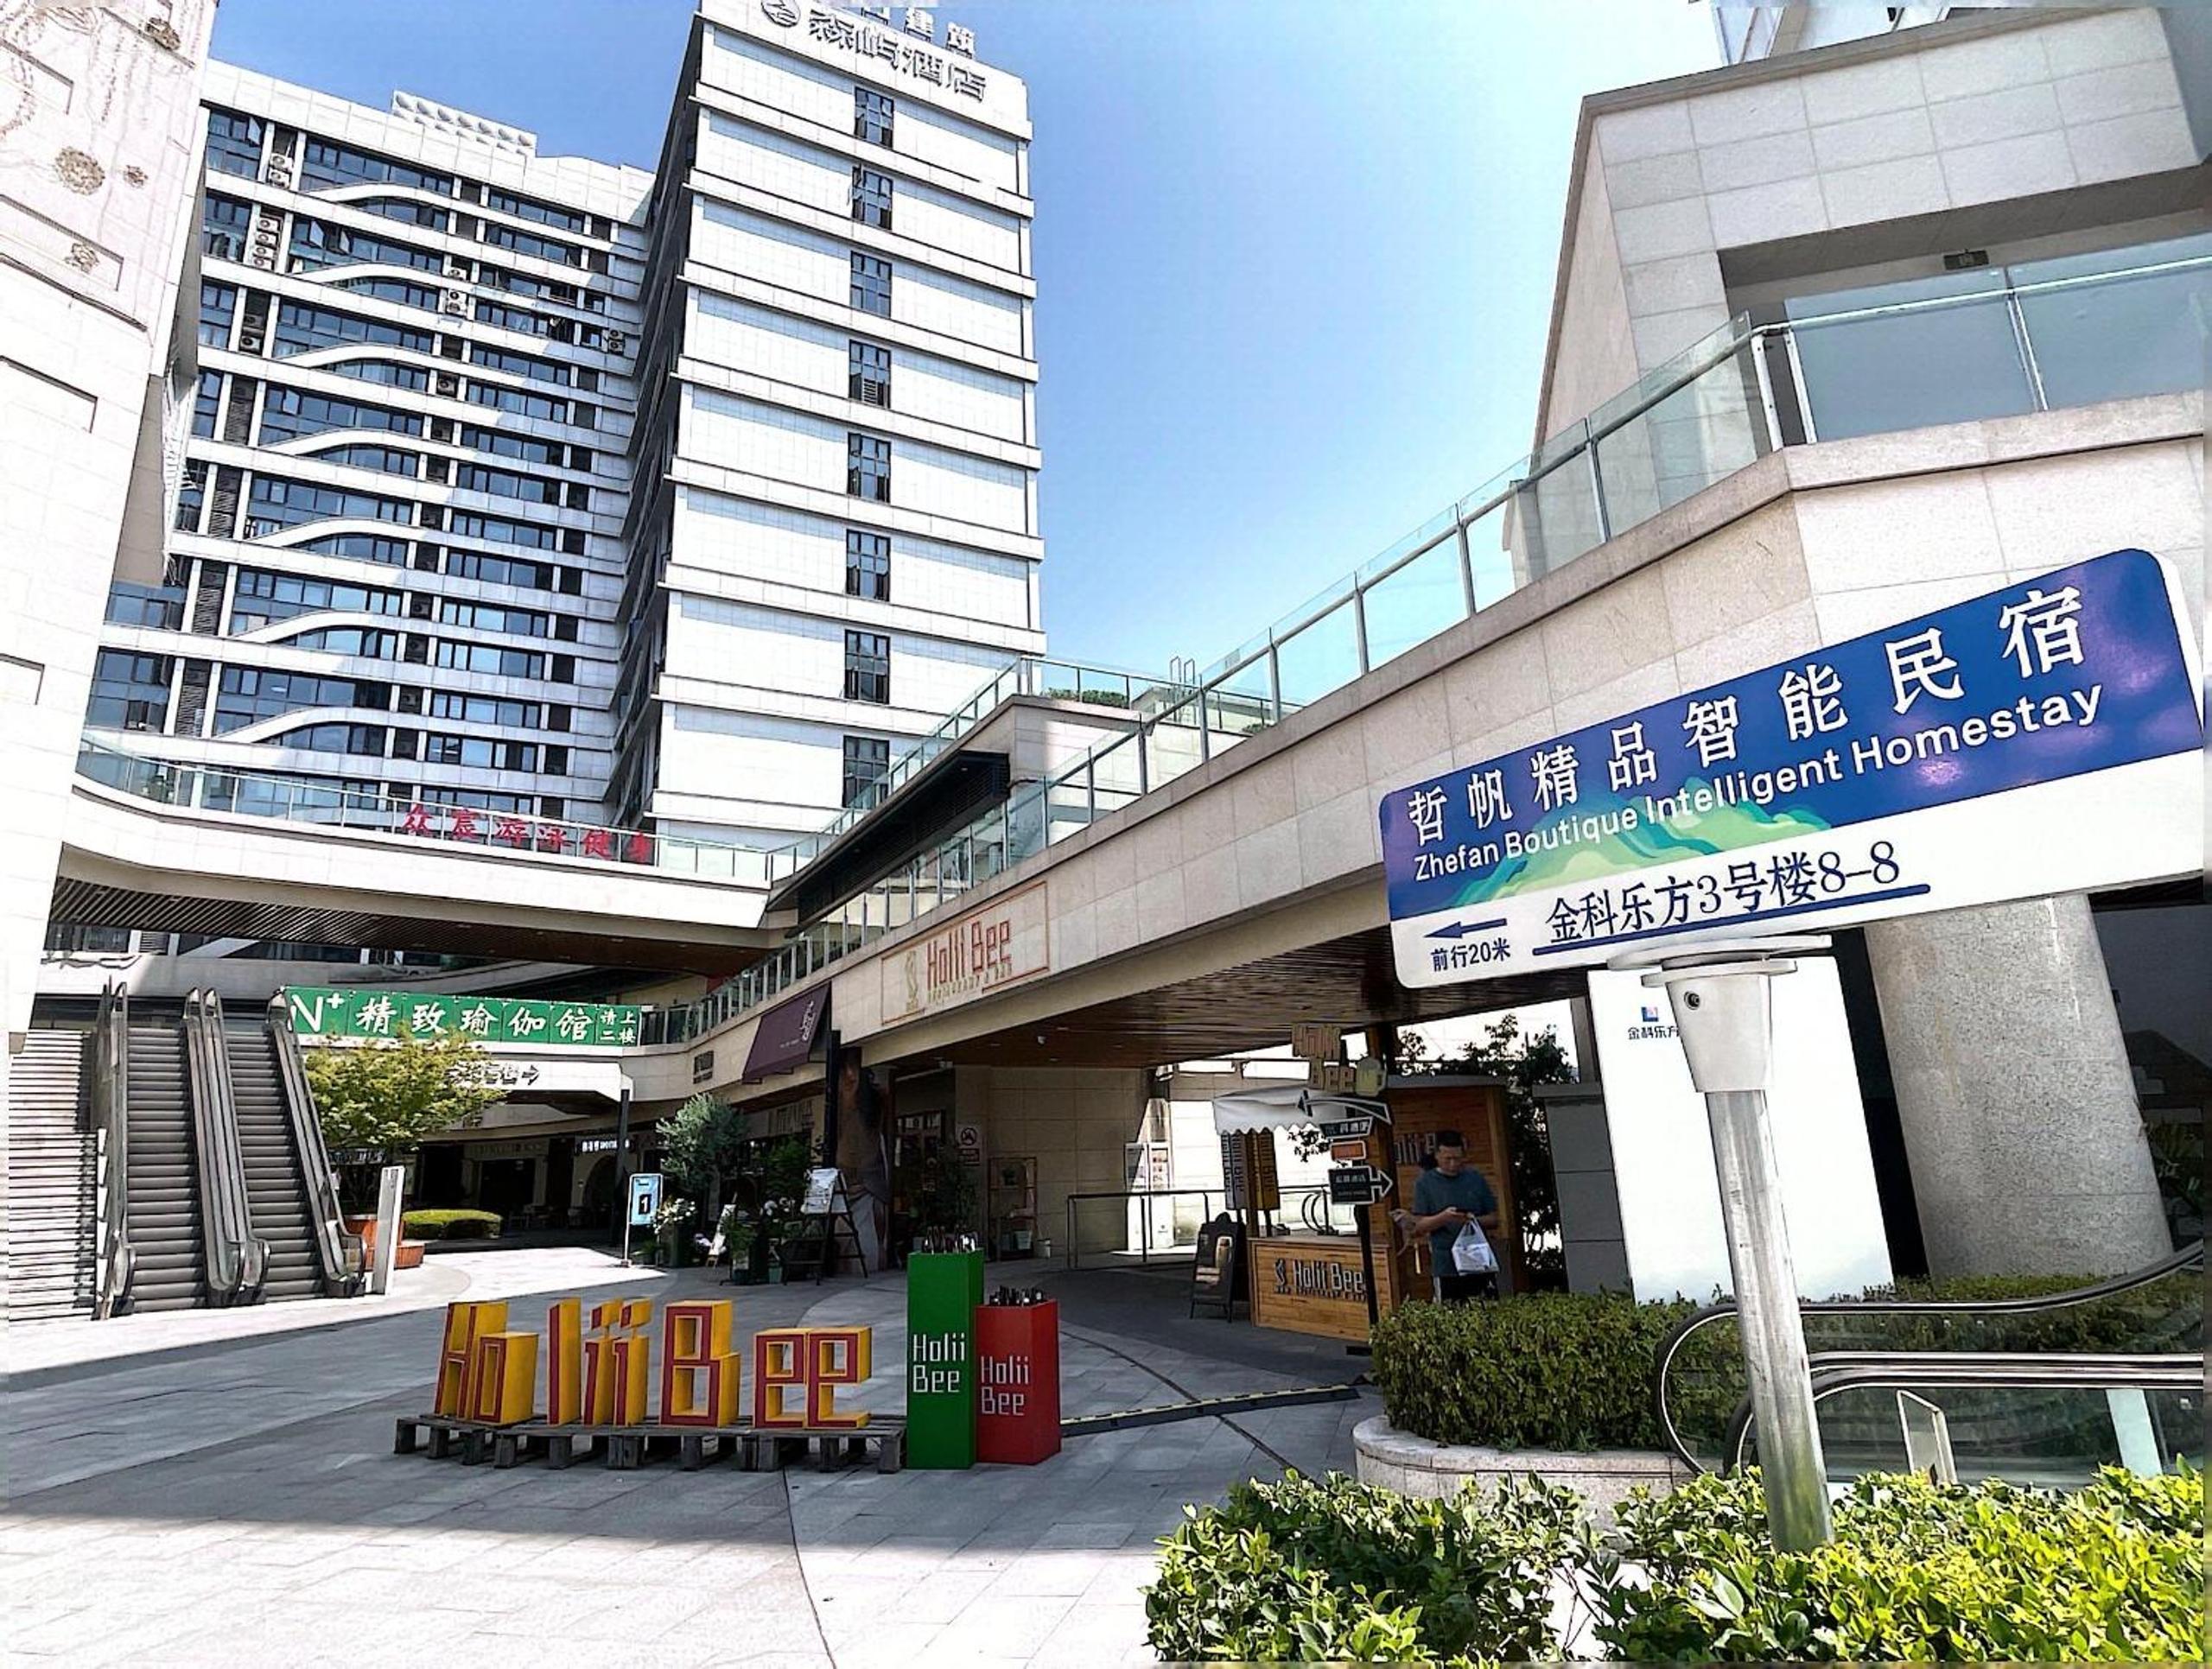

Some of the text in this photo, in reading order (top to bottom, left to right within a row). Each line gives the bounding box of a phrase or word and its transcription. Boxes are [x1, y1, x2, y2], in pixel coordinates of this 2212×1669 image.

[1407, 584, 2086, 847] 哲帆精品智能民宿
[1414, 684, 2104, 882] Zhefan Boutique Intelligent Homestay
[971, 919, 1012, 974] Bee
[1430, 937, 1511, 973] 前行20米
[354, 994, 594, 1042] 精致瑜伽馆
[1330, 1262, 1364, 1294] Bee
[912, 1332, 965, 1362] Holii
[912, 1364, 960, 1393] Bee
[981, 1355, 1030, 1385] Holii
[982, 1386, 1025, 1417] Bee
